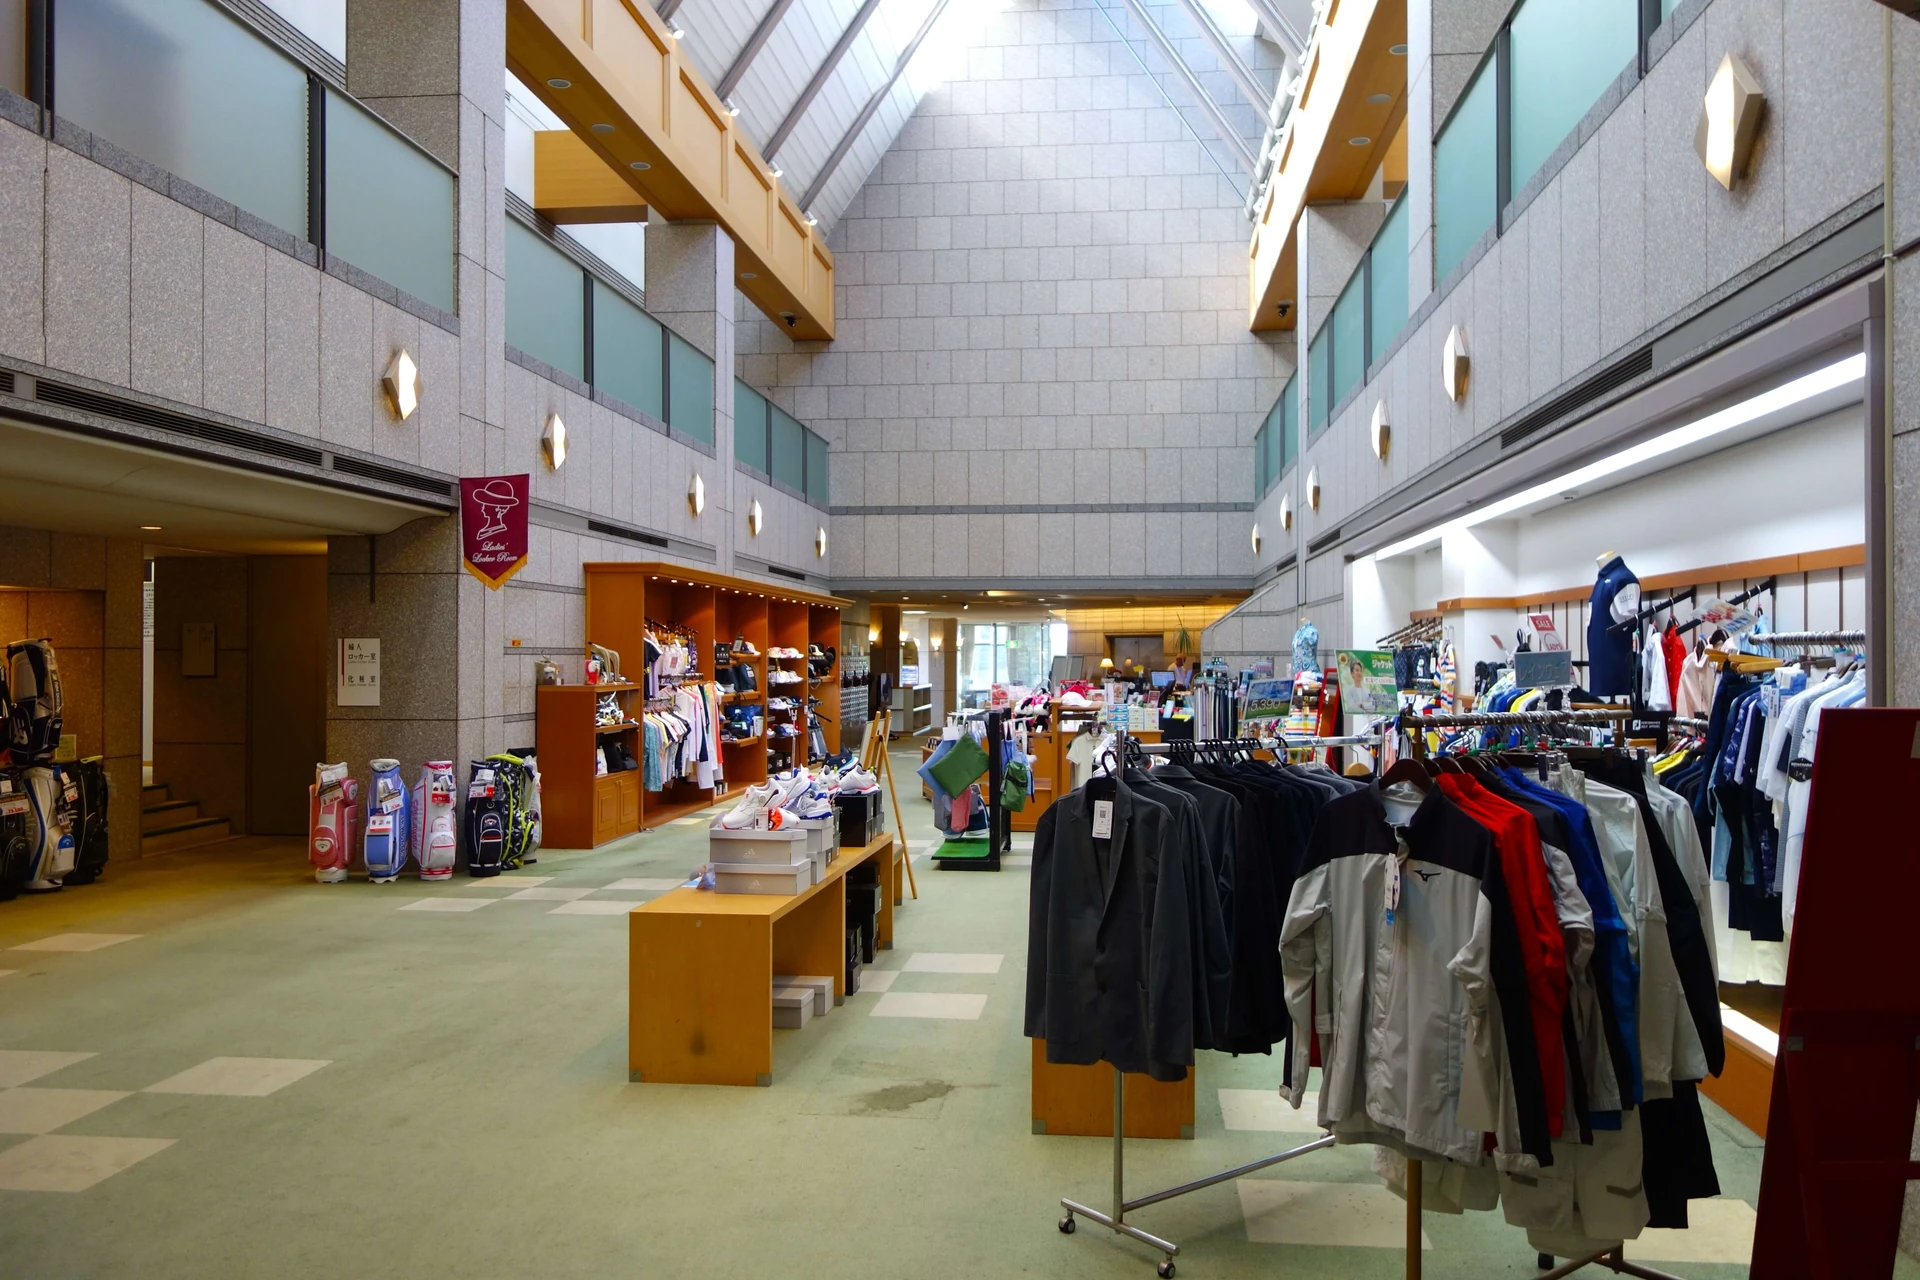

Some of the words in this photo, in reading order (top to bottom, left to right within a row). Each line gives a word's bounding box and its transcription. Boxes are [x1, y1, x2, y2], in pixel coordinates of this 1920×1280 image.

[496, 552, 518, 562] Room
[1535, 620, 1552, 628] SALE
[348, 652, 376, 660] ロッカー室
